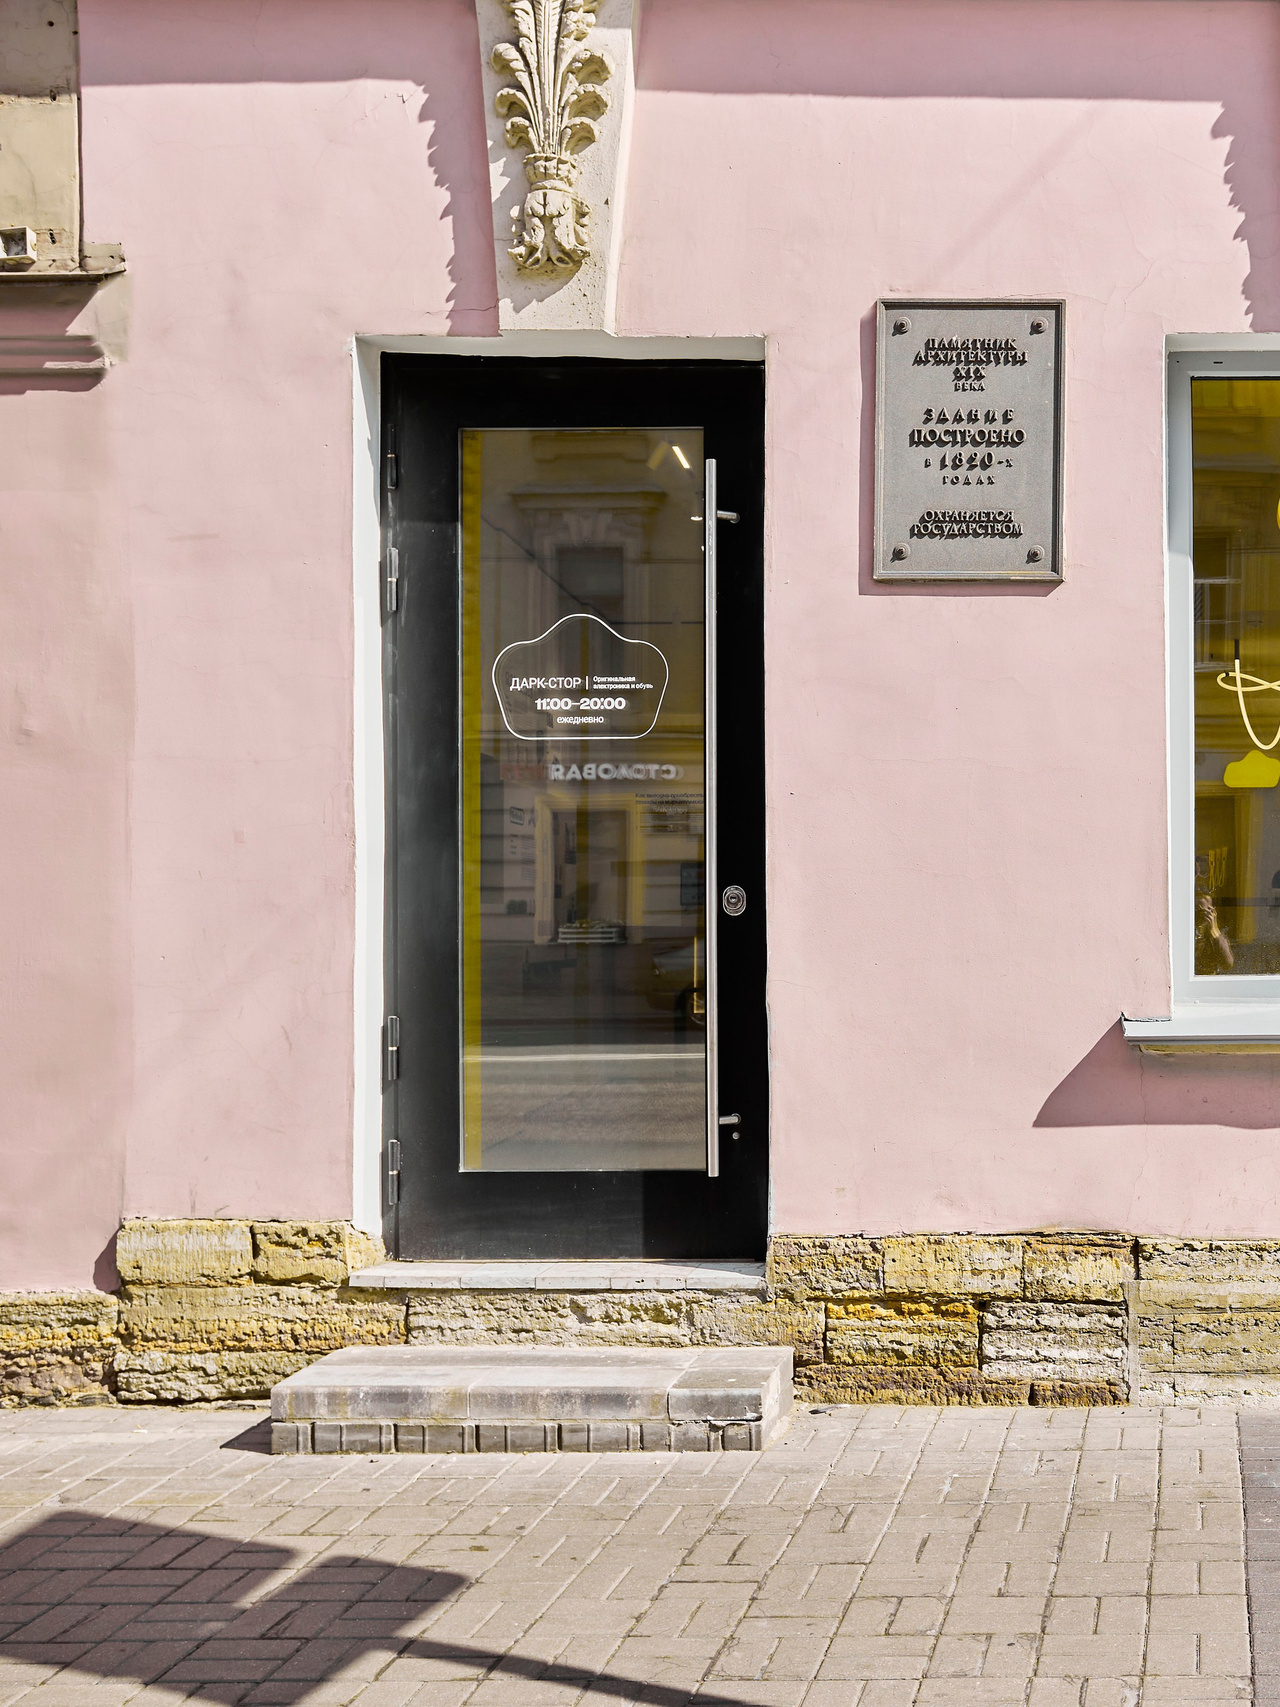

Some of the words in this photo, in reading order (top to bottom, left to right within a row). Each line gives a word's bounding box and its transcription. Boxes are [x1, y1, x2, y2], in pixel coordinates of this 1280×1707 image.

[926, 337, 1017, 350] ПАМЯТНИК
[914, 350, 1029, 364] АРХИТЕКТУРЫ
[954, 366, 987, 380] XIX
[954, 381, 986, 391] ВЕКА
[924, 408, 1015, 422] ЗДАНИЕ
[911, 428, 1027, 445] ПОСТРОЕНО
[943, 474, 996, 485] ГОДАХ
[922, 510, 1015, 523] ОХРАНЯЕТСЯ
[912, 522, 1024, 537] ГОСУДАРСТВОМ
[510, 677, 582, 691] ДАРК-СТОР
[557, 715, 604, 724] ежедневно
